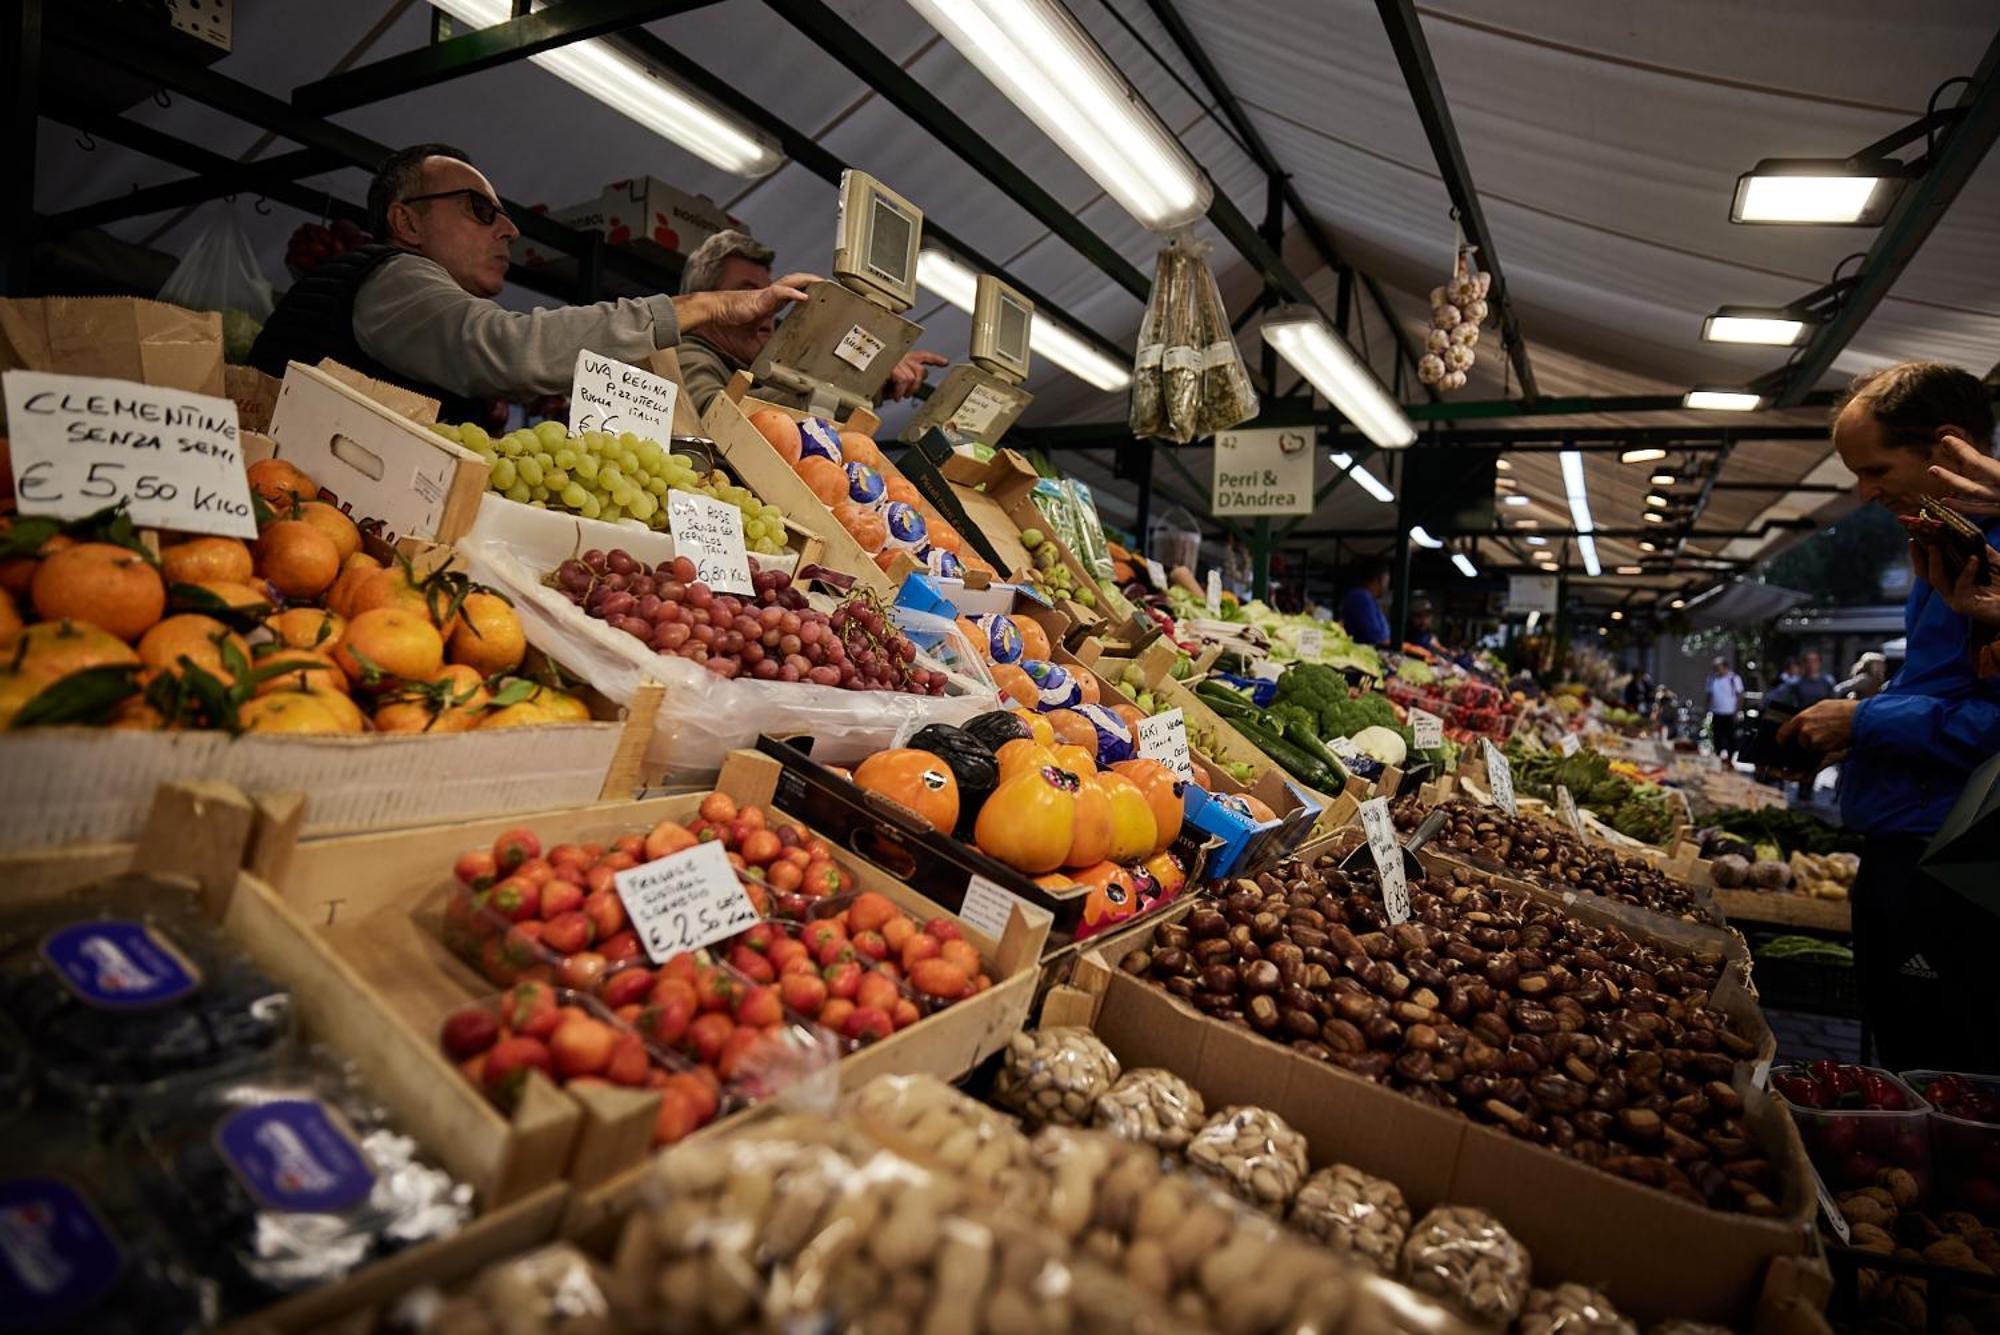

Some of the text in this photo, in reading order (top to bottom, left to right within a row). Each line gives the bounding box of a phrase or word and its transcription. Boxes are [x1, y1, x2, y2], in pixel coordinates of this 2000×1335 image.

[584, 359, 667, 399] UVA REGINA
[23, 391, 236, 440] CLEMENTINE
[627, 407, 660, 426] ITALIA
[66, 421, 235, 464] SENZA SEMI
[1221, 435, 1238, 450] 42
[18, 461, 63, 501] €
[193, 486, 248, 517] KILO
[1218, 469, 1278, 488] Perri &
[1217, 490, 1297, 508] D'Andrea
